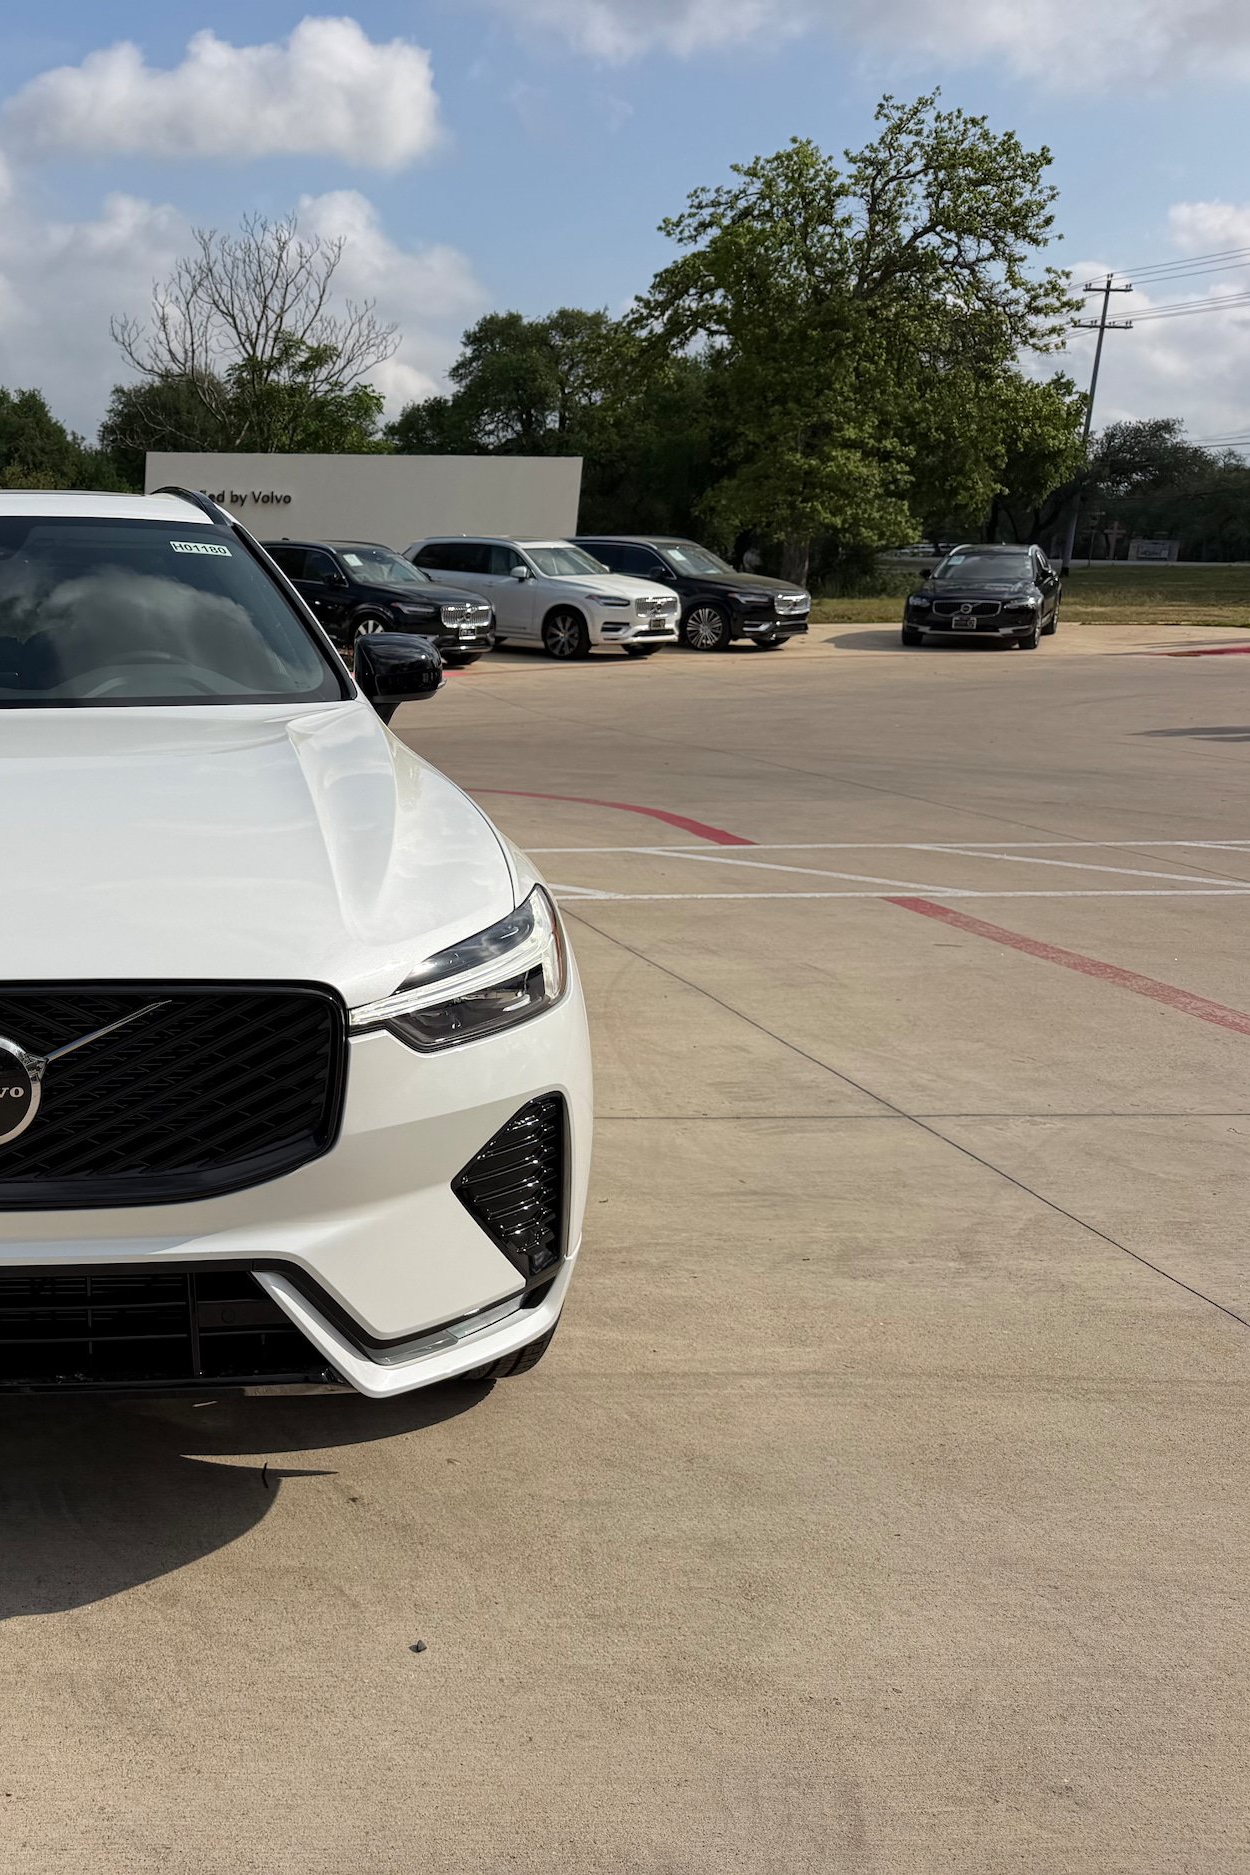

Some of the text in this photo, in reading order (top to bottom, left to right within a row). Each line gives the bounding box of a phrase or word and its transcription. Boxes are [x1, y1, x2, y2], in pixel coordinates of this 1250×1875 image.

[230, 491, 248, 507] by
[251, 491, 292, 504] Volvo
[172, 543, 227, 554] H01180
